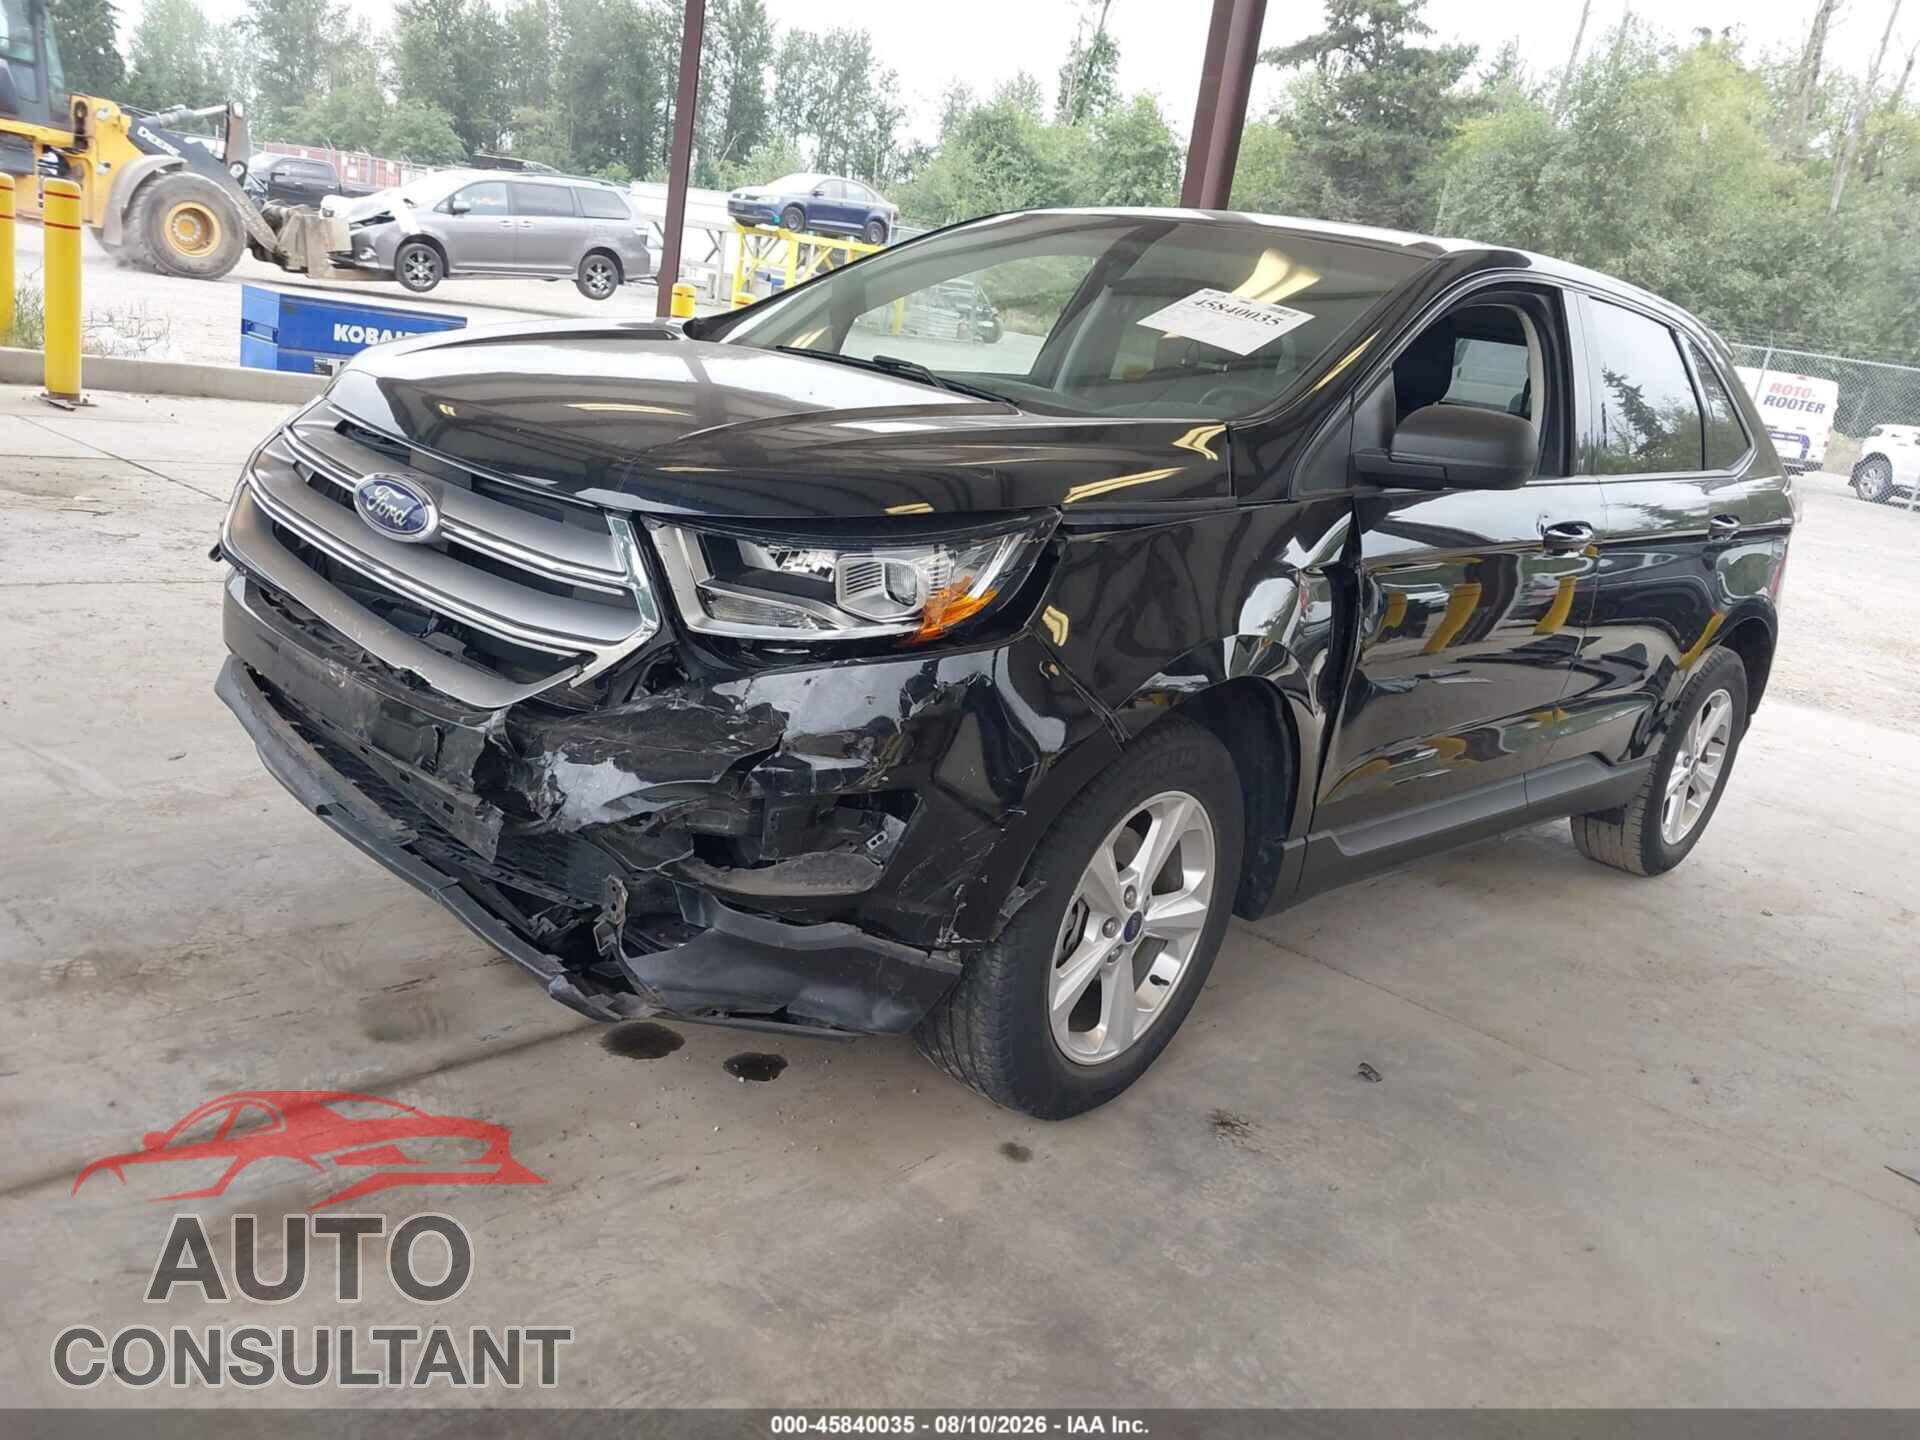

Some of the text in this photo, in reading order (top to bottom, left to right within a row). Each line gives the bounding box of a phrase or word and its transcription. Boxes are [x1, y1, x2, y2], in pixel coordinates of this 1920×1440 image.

[334, 323, 417, 345] KOBA
[1763, 395, 1826, 414] ROOTER
[366, 485, 414, 527] Ford
